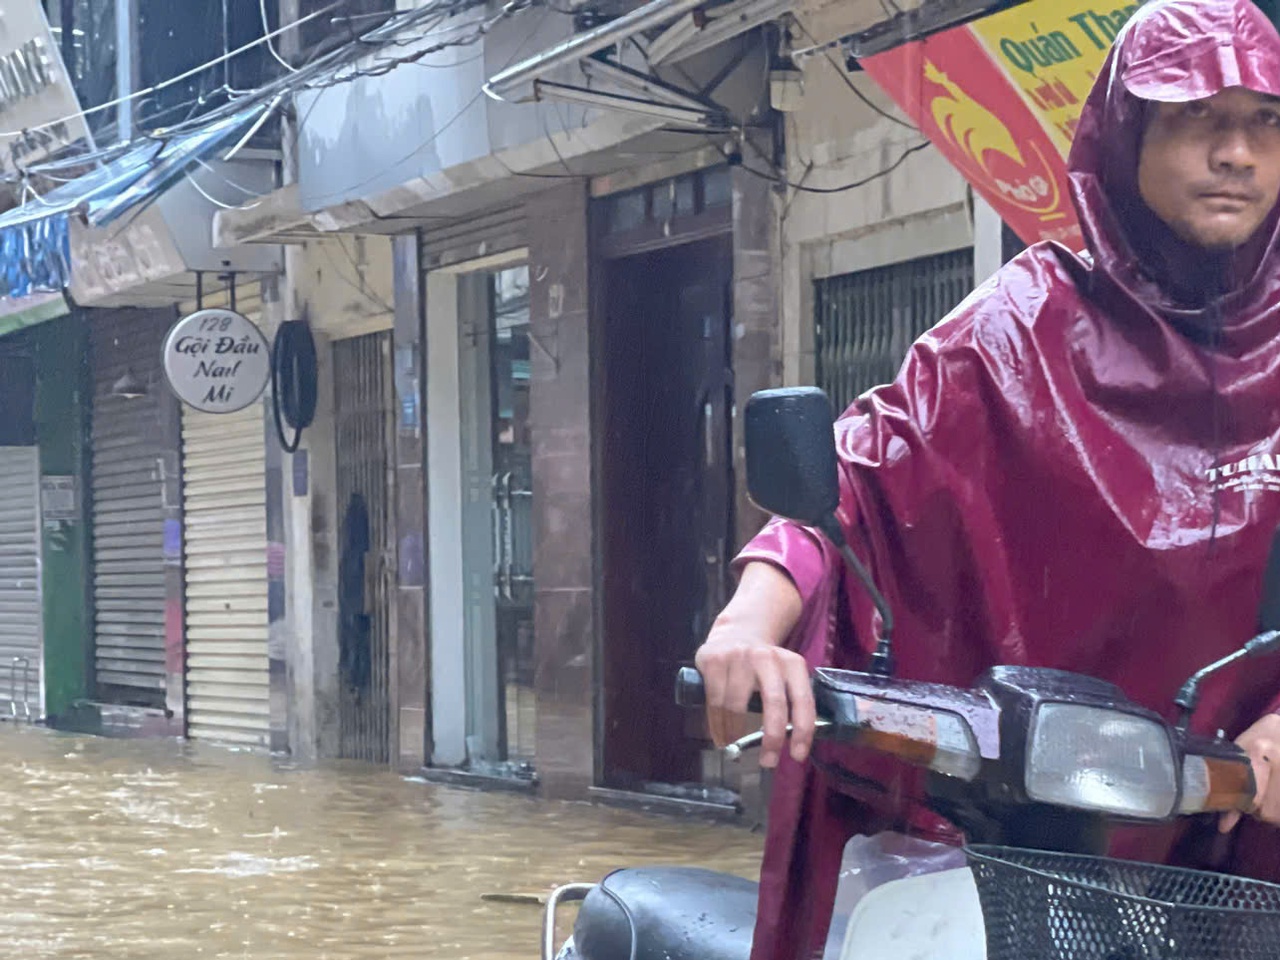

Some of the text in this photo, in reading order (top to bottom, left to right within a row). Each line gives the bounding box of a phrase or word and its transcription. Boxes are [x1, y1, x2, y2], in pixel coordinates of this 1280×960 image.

[1000, 21, 1083, 78] Quán
[199, 317, 232, 332] 128
[192, 360, 242, 379] Nail
